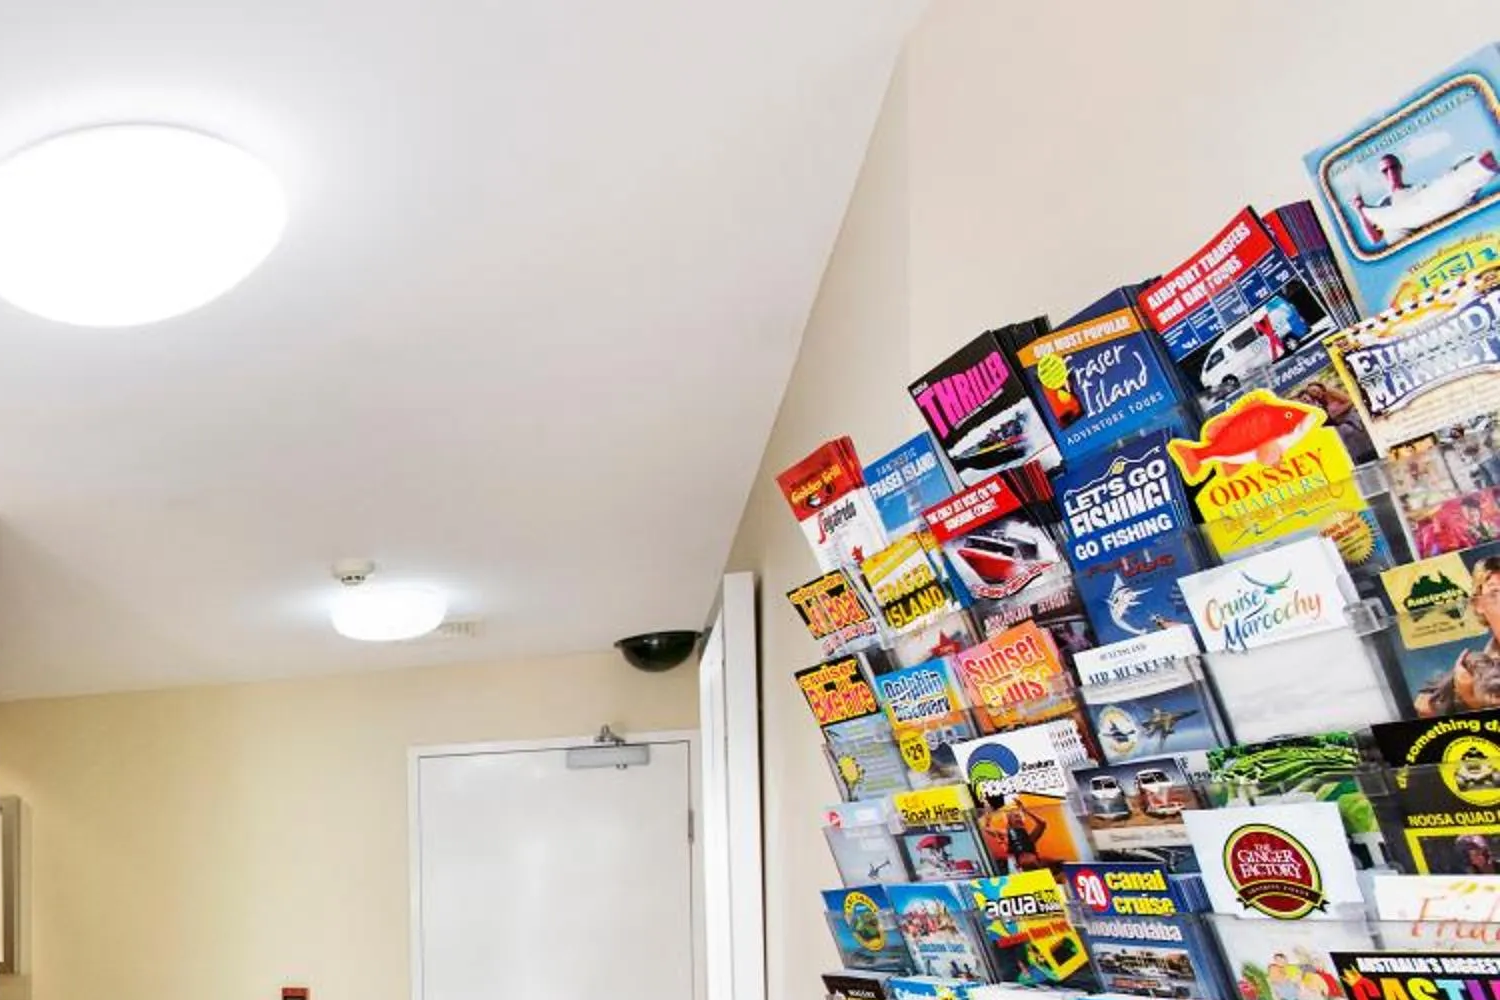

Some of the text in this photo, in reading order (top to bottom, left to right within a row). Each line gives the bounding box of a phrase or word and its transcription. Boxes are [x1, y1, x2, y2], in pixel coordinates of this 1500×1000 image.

[1147, 221, 1252, 311] AIRPORT TRANSFERS
[1182, 279, 1208, 308] DAY
[1054, 332, 1083, 351] MOST
[1083, 316, 1131, 342] POPULAR
[1081, 351, 1148, 419] Island
[1067, 391, 1165, 446] ADVENTURE TOURS
[902, 451, 936, 482] ISLAND
[1209, 447, 1327, 508] ODYSSEY
[1064, 459, 1168, 517] LET'S GO
[1069, 477, 1173, 539] FISHING!
[1074, 513, 1174, 561] GO FISHING
[883, 584, 947, 629] ISLAND
[1204, 587, 1261, 633] Cruise
[1222, 589, 1322, 655] Maroochy
[962, 635, 1045, 684] Sunset
[1088, 655, 1177, 686] AIR MUSEUM
[1406, 718, 1481, 762] something
[1406, 810, 1495, 828] NOOSA QUAD
[1237, 848, 1296, 864] GINGER
[1253, 843, 1271, 852] THE
[1105, 869, 1167, 892] canal
[1239, 862, 1303, 880] FACTORY
[985, 895, 1038, 921] aqua
[1111, 893, 1177, 916] cruise
[1354, 957, 1443, 974] AUSTRALIA'S
